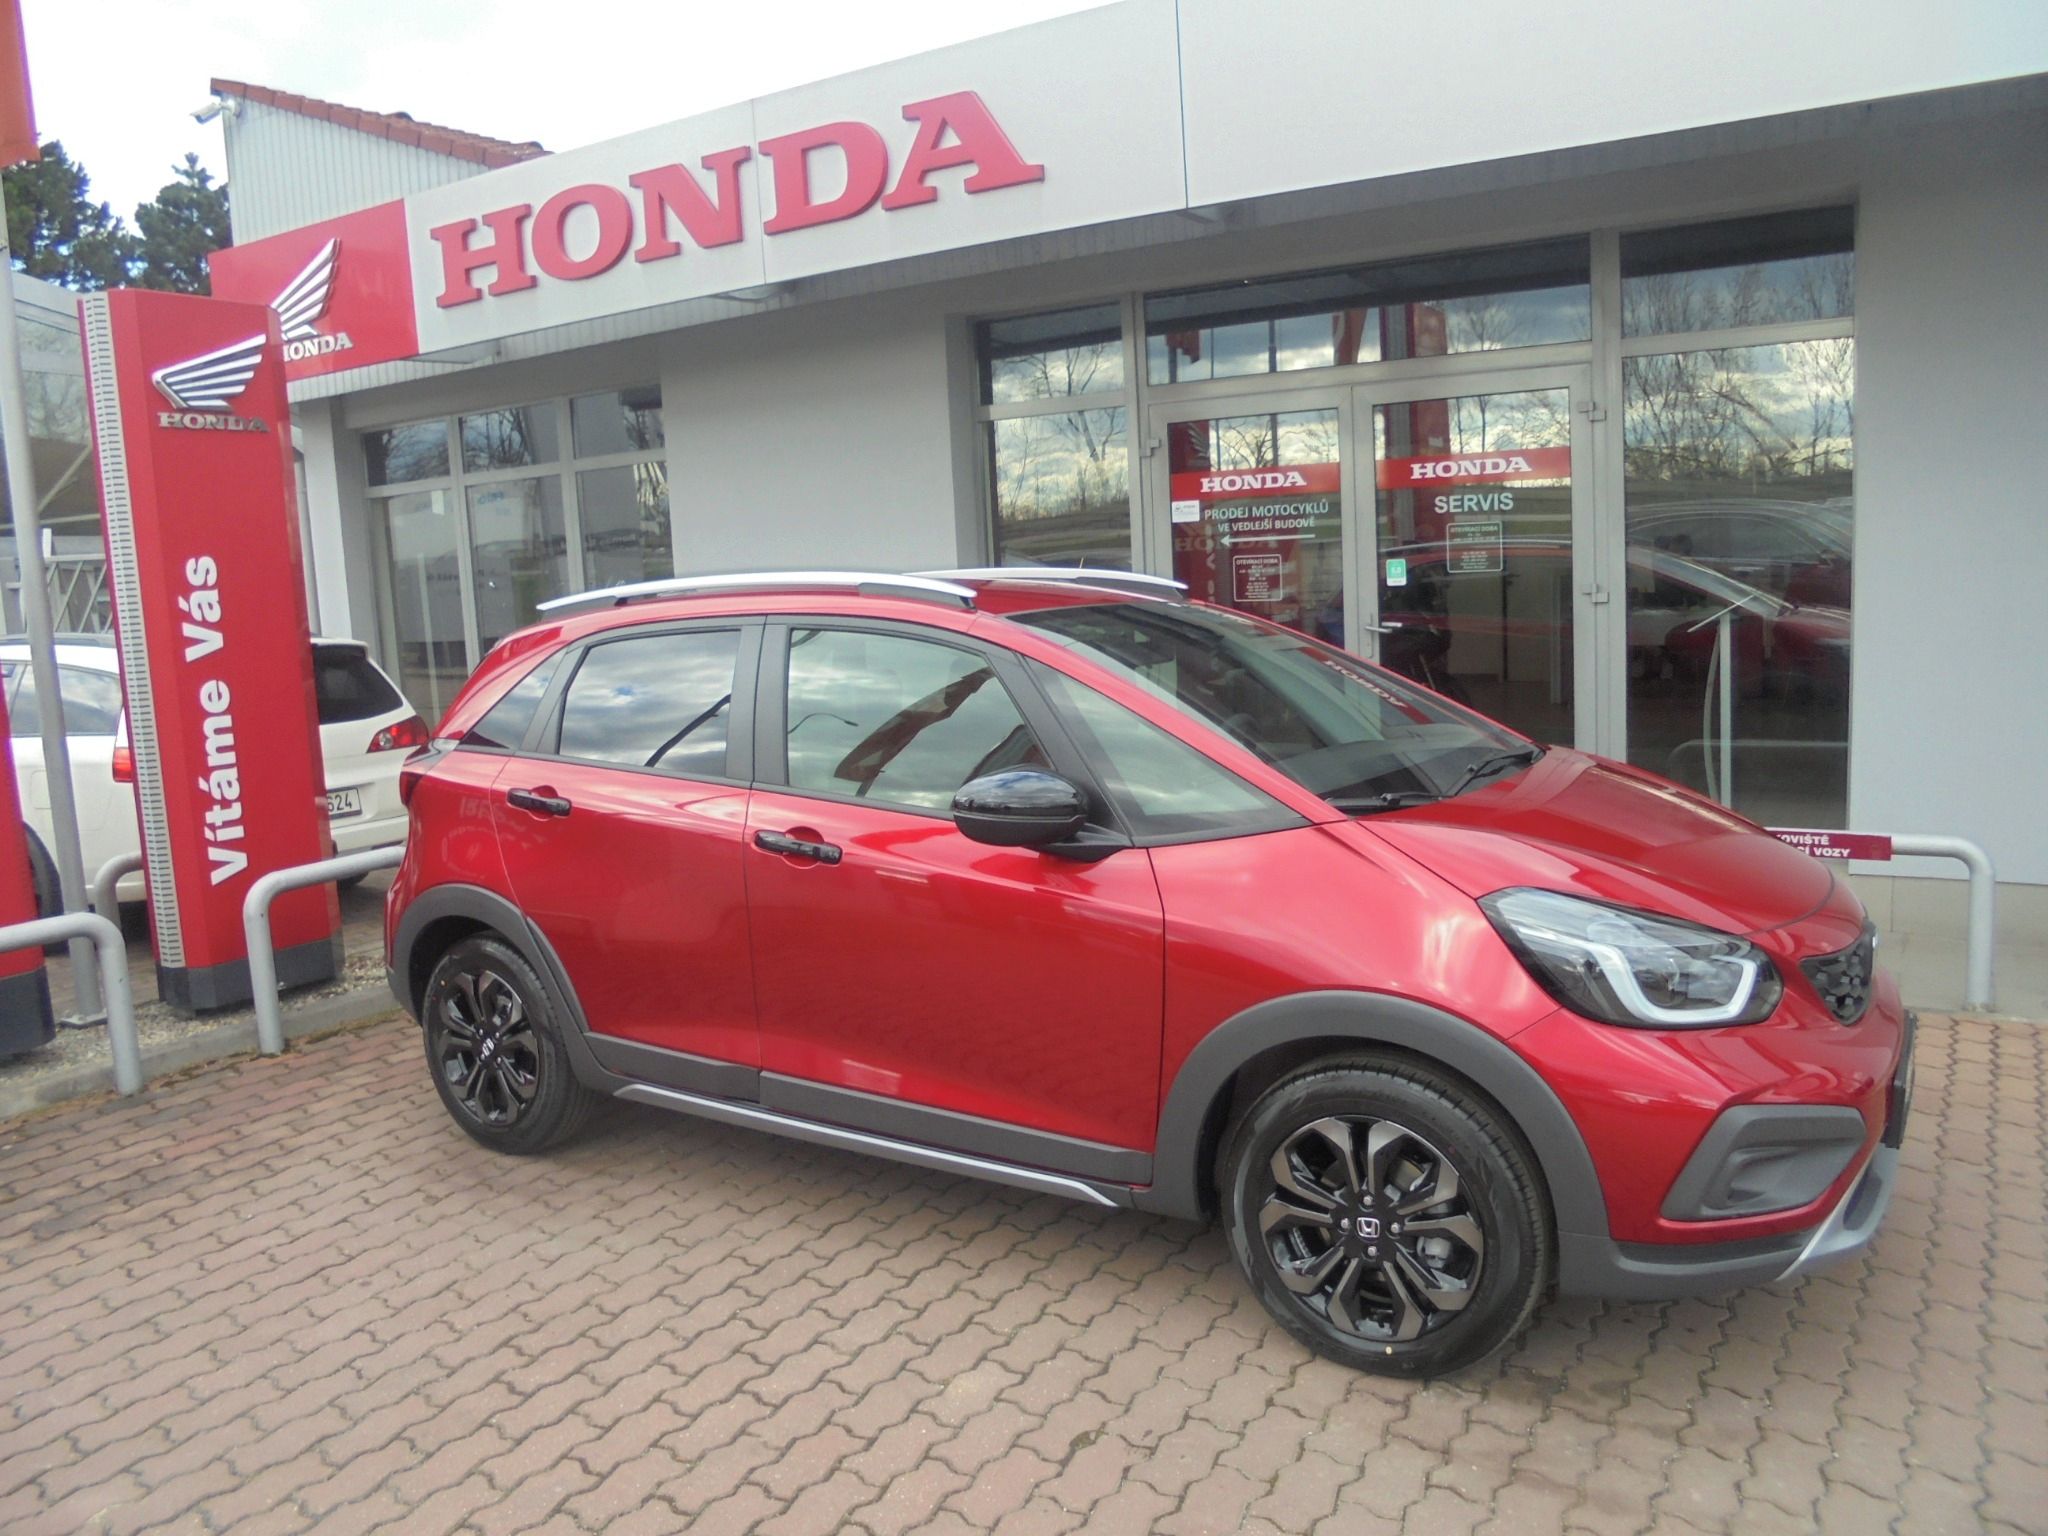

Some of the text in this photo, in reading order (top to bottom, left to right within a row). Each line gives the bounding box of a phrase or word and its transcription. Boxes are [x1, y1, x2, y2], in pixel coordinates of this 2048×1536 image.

[429, 90, 1045, 308] HONDA
[157, 412, 271, 432] HONDA
[1410, 456, 1532, 479] HONDA
[1200, 471, 1307, 493] HONDA
[1204, 507, 1249, 520] PRODEJ
[1252, 499, 1329, 517] MOTOCYKLŮ
[1434, 492, 1514, 514] SERVIS
[1217, 523, 1230, 532] VE
[1232, 518, 1273, 532] VEDLEJŠÍ
[178, 555, 249, 886] Vítáme Vás
[1776, 834, 1829, 845] OVIŠTĚ
[1813, 847, 1850, 857] VOZY
